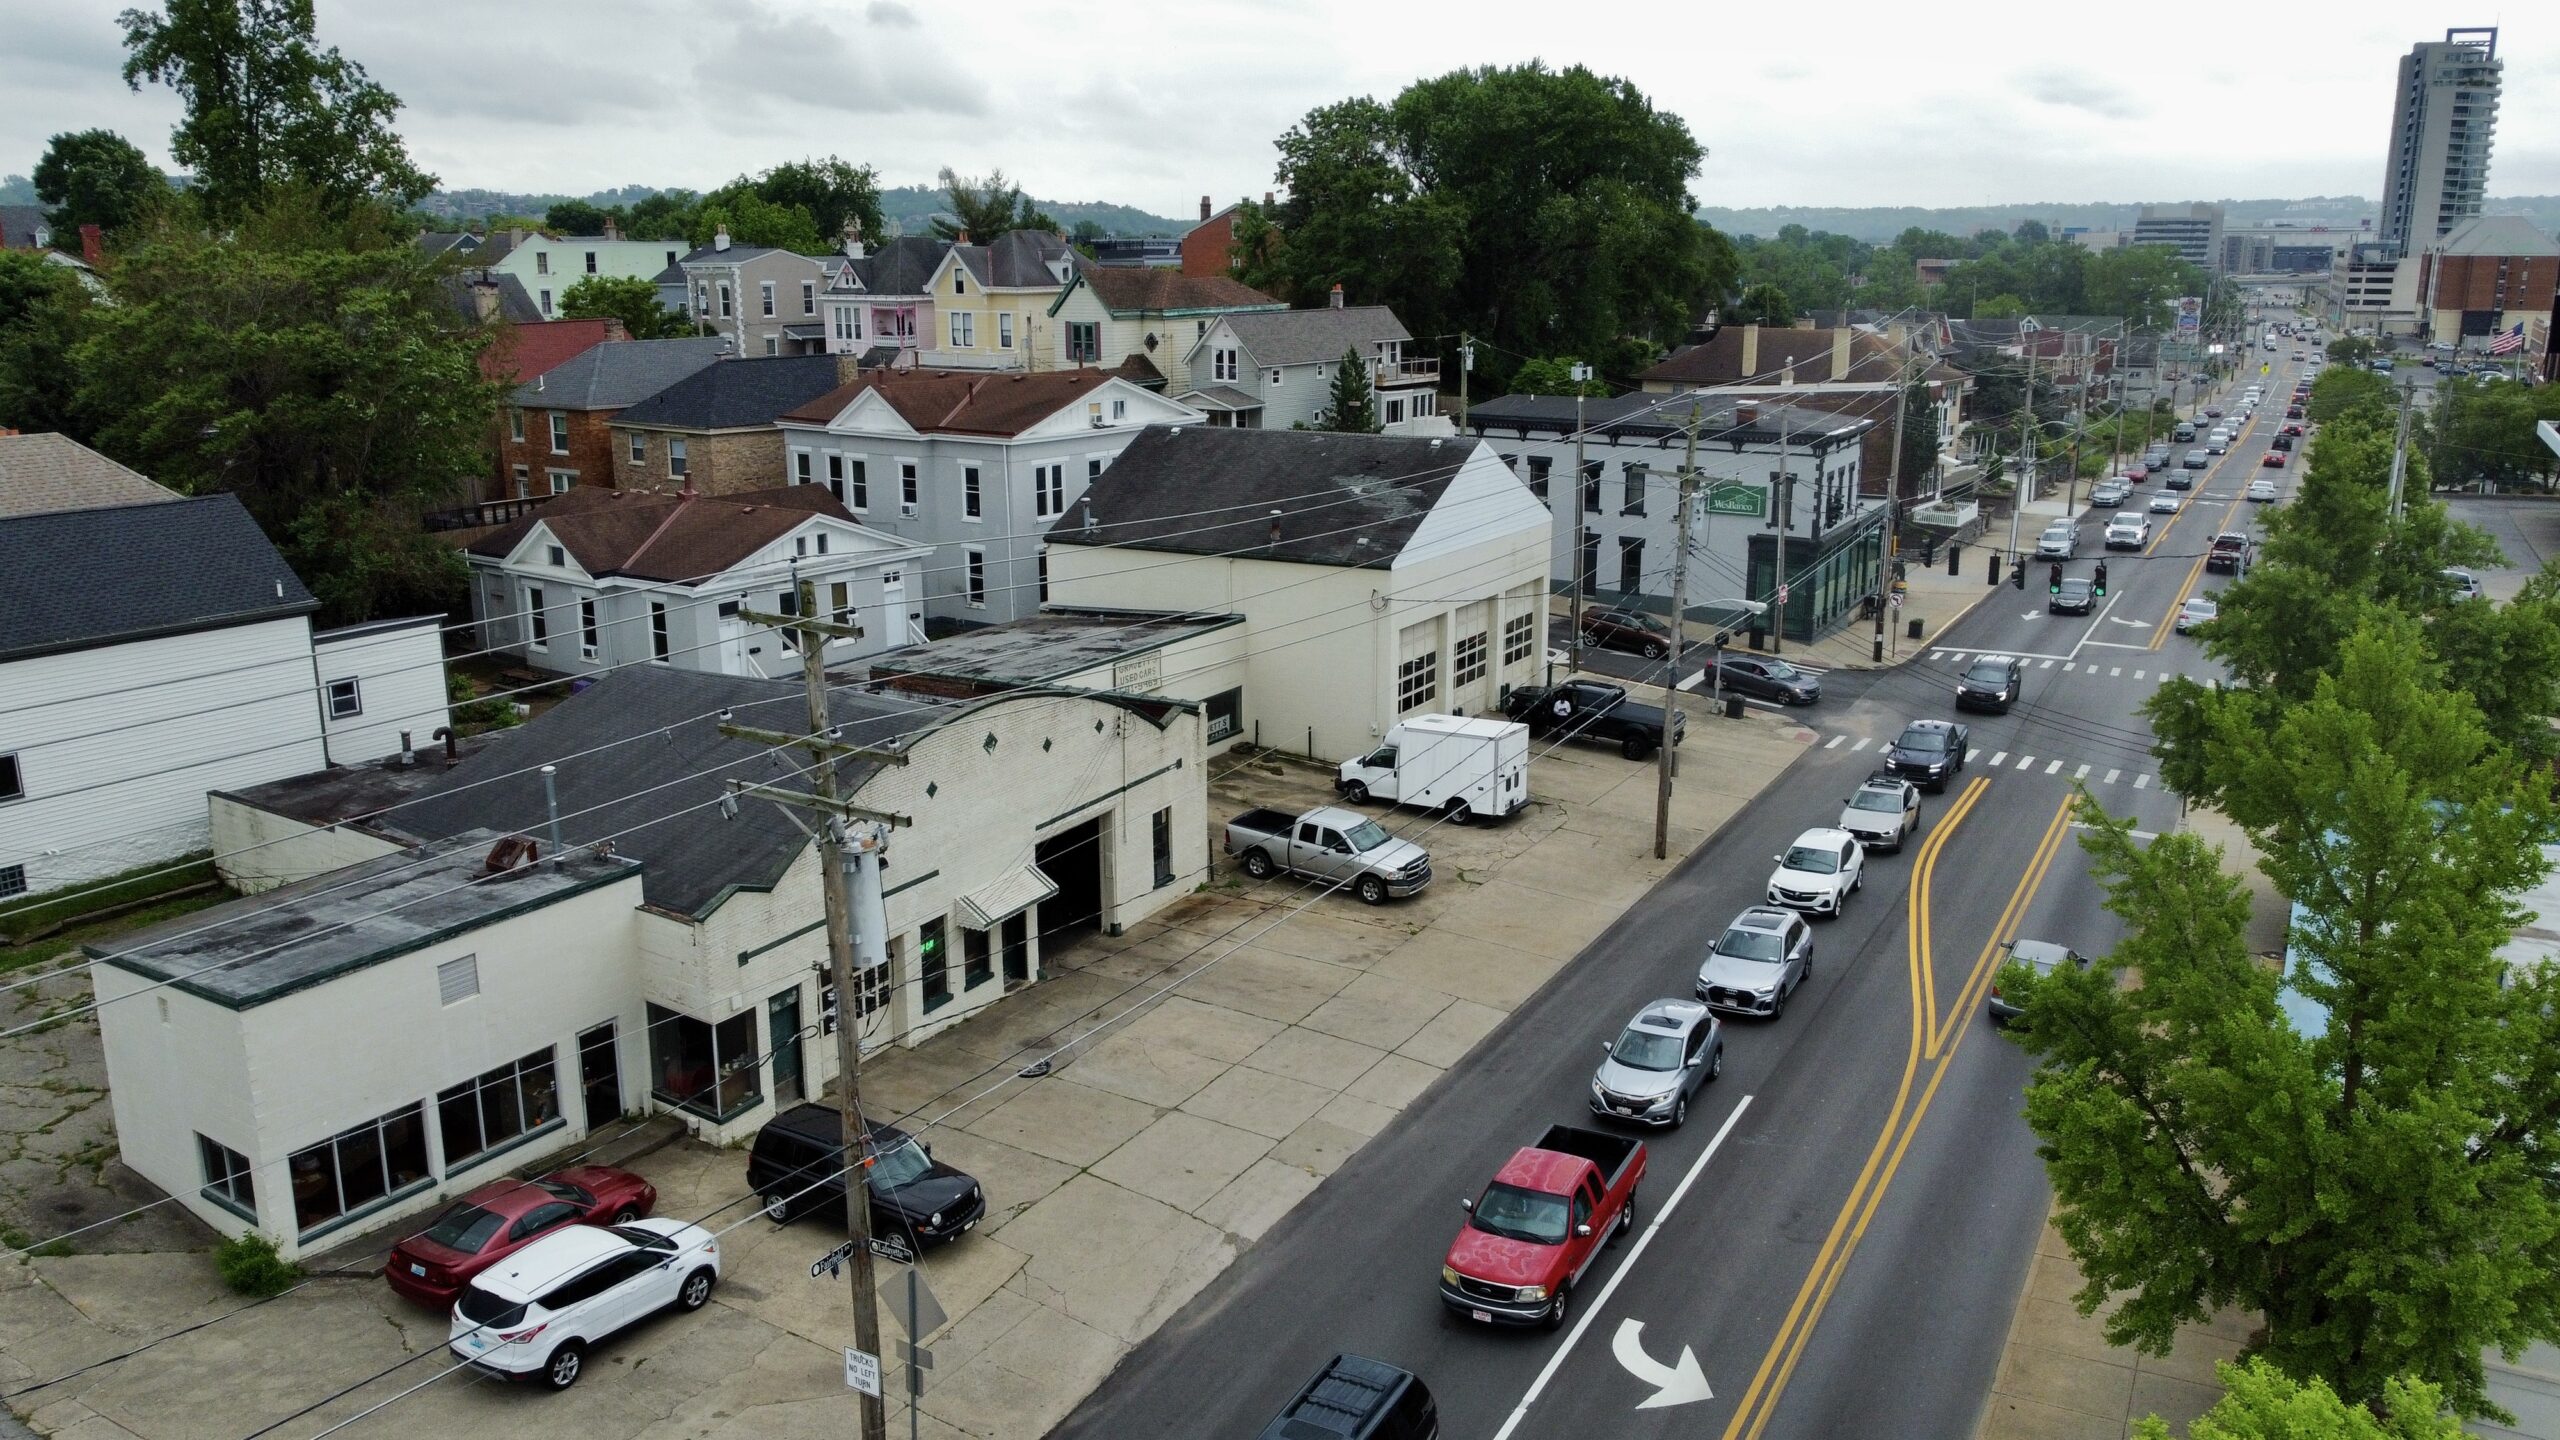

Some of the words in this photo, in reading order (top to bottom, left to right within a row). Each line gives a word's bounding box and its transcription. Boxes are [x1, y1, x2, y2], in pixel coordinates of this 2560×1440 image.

[1120, 672, 1138, 685] USED
[1139, 667, 1156, 679] CARS
[878, 1242, 904, 1259] Lafayette
[820, 1247, 844, 1272] Fairfield
[850, 1352, 874, 1368] TRUCKS
[849, 1363, 858, 1373] NO
[861, 1367, 875, 1379] LEFT
[855, 1376, 871, 1389] TURN
